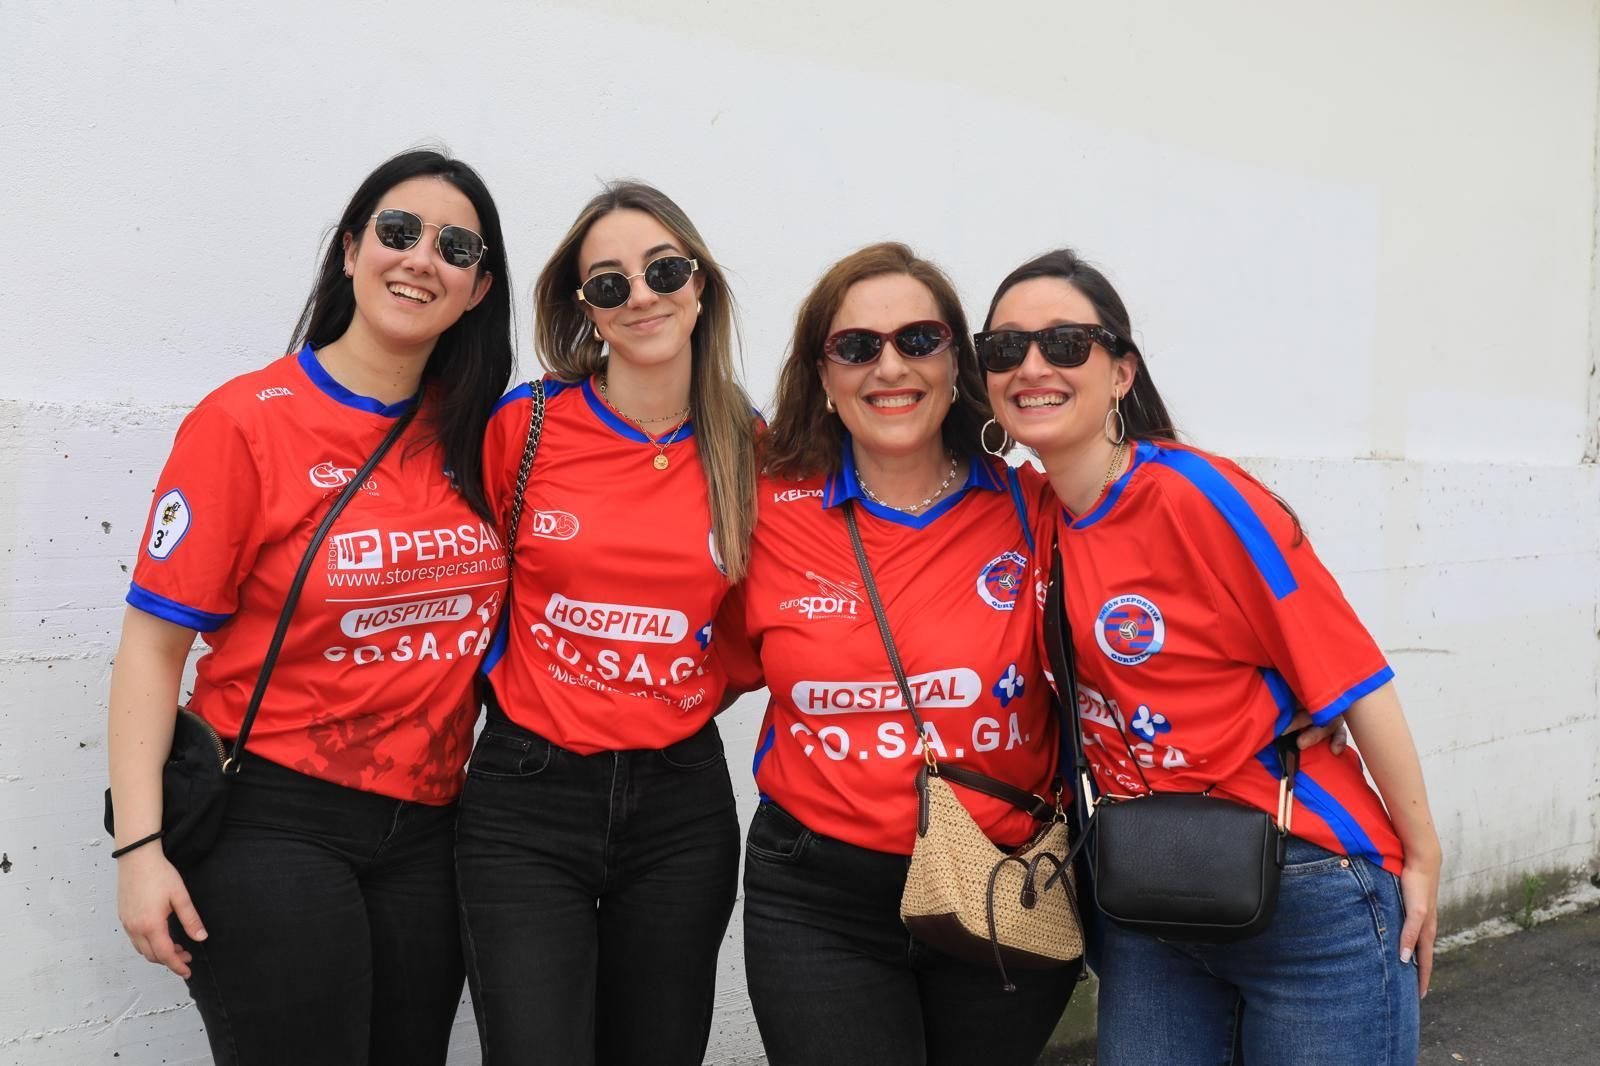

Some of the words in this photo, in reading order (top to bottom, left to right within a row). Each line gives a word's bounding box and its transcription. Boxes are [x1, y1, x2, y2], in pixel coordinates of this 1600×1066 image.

[355, 599, 460, 633] HOSPITAL
[552, 601, 674, 638] HOSPITAL
[1120, 597, 1161, 622] DEPORTIVA
